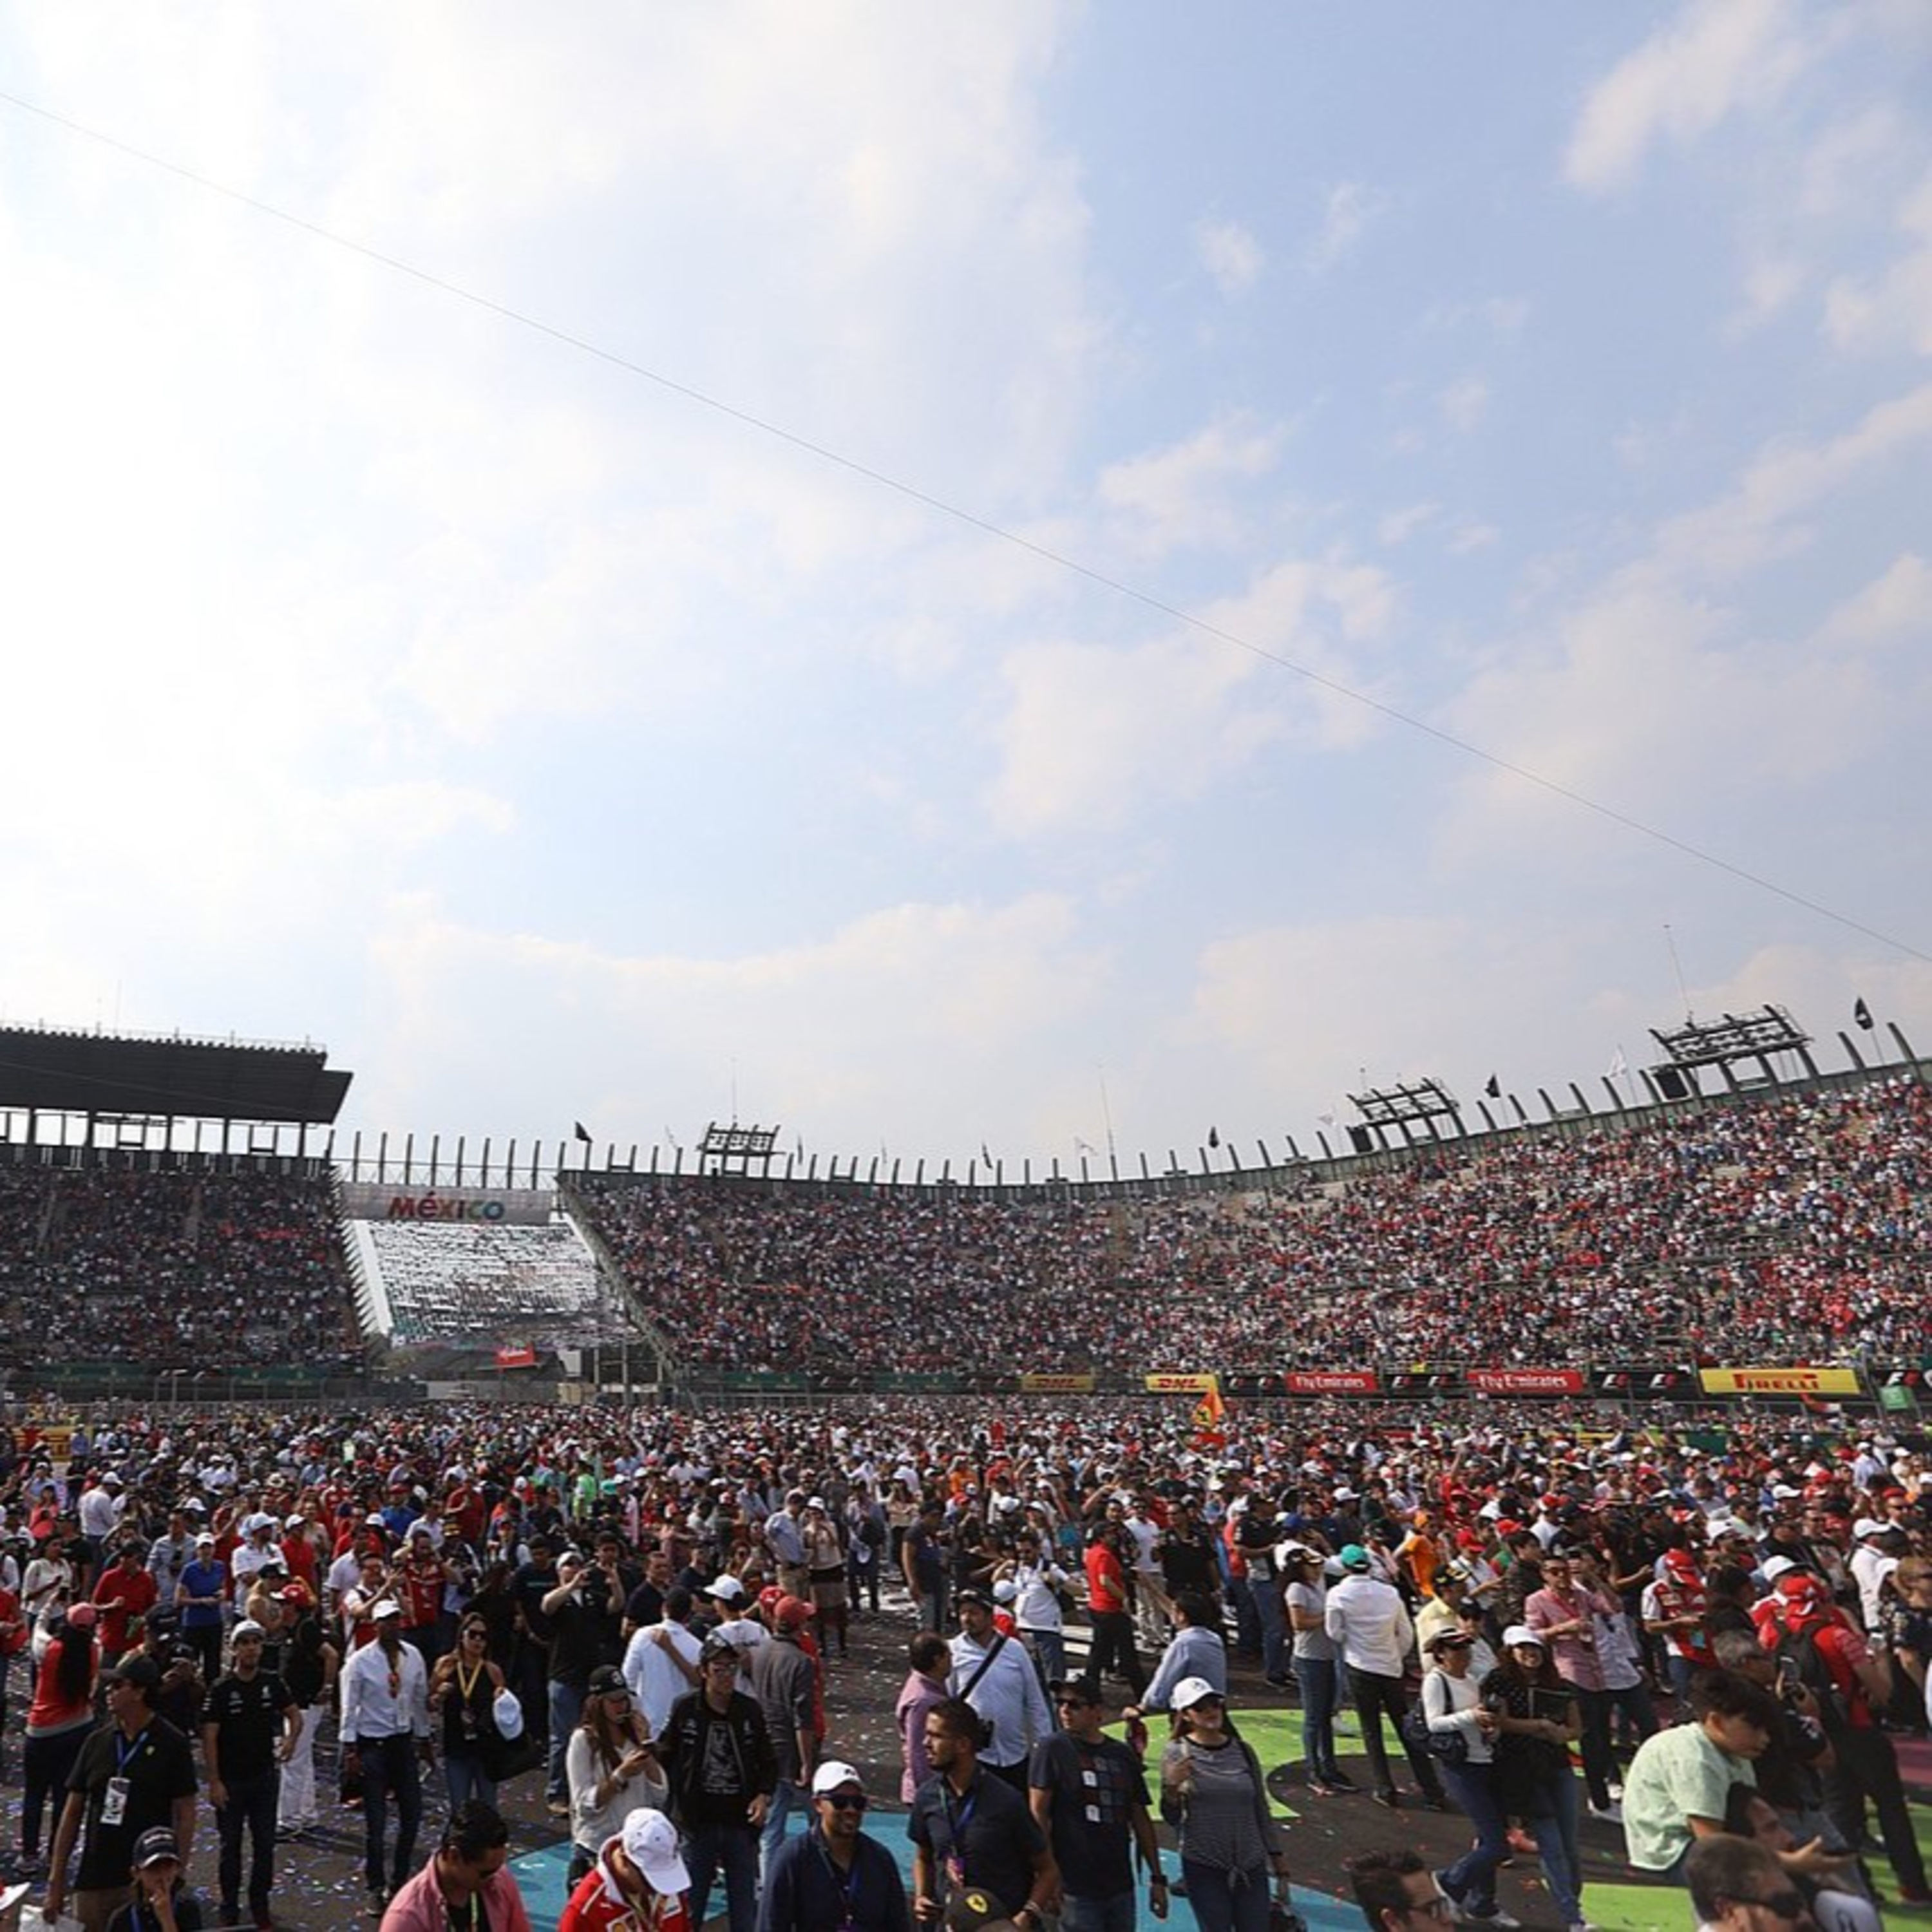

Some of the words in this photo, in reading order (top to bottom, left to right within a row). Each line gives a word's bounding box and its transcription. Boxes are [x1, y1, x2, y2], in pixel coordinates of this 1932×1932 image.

[1157, 1378, 1200, 1388] DHL
[1316, 1376, 1366, 1387] Emirates
[1478, 1374, 1504, 1389] Fly
[1504, 1374, 1568, 1388] Emirates
[1732, 1373, 1820, 1390] PIRELLI
